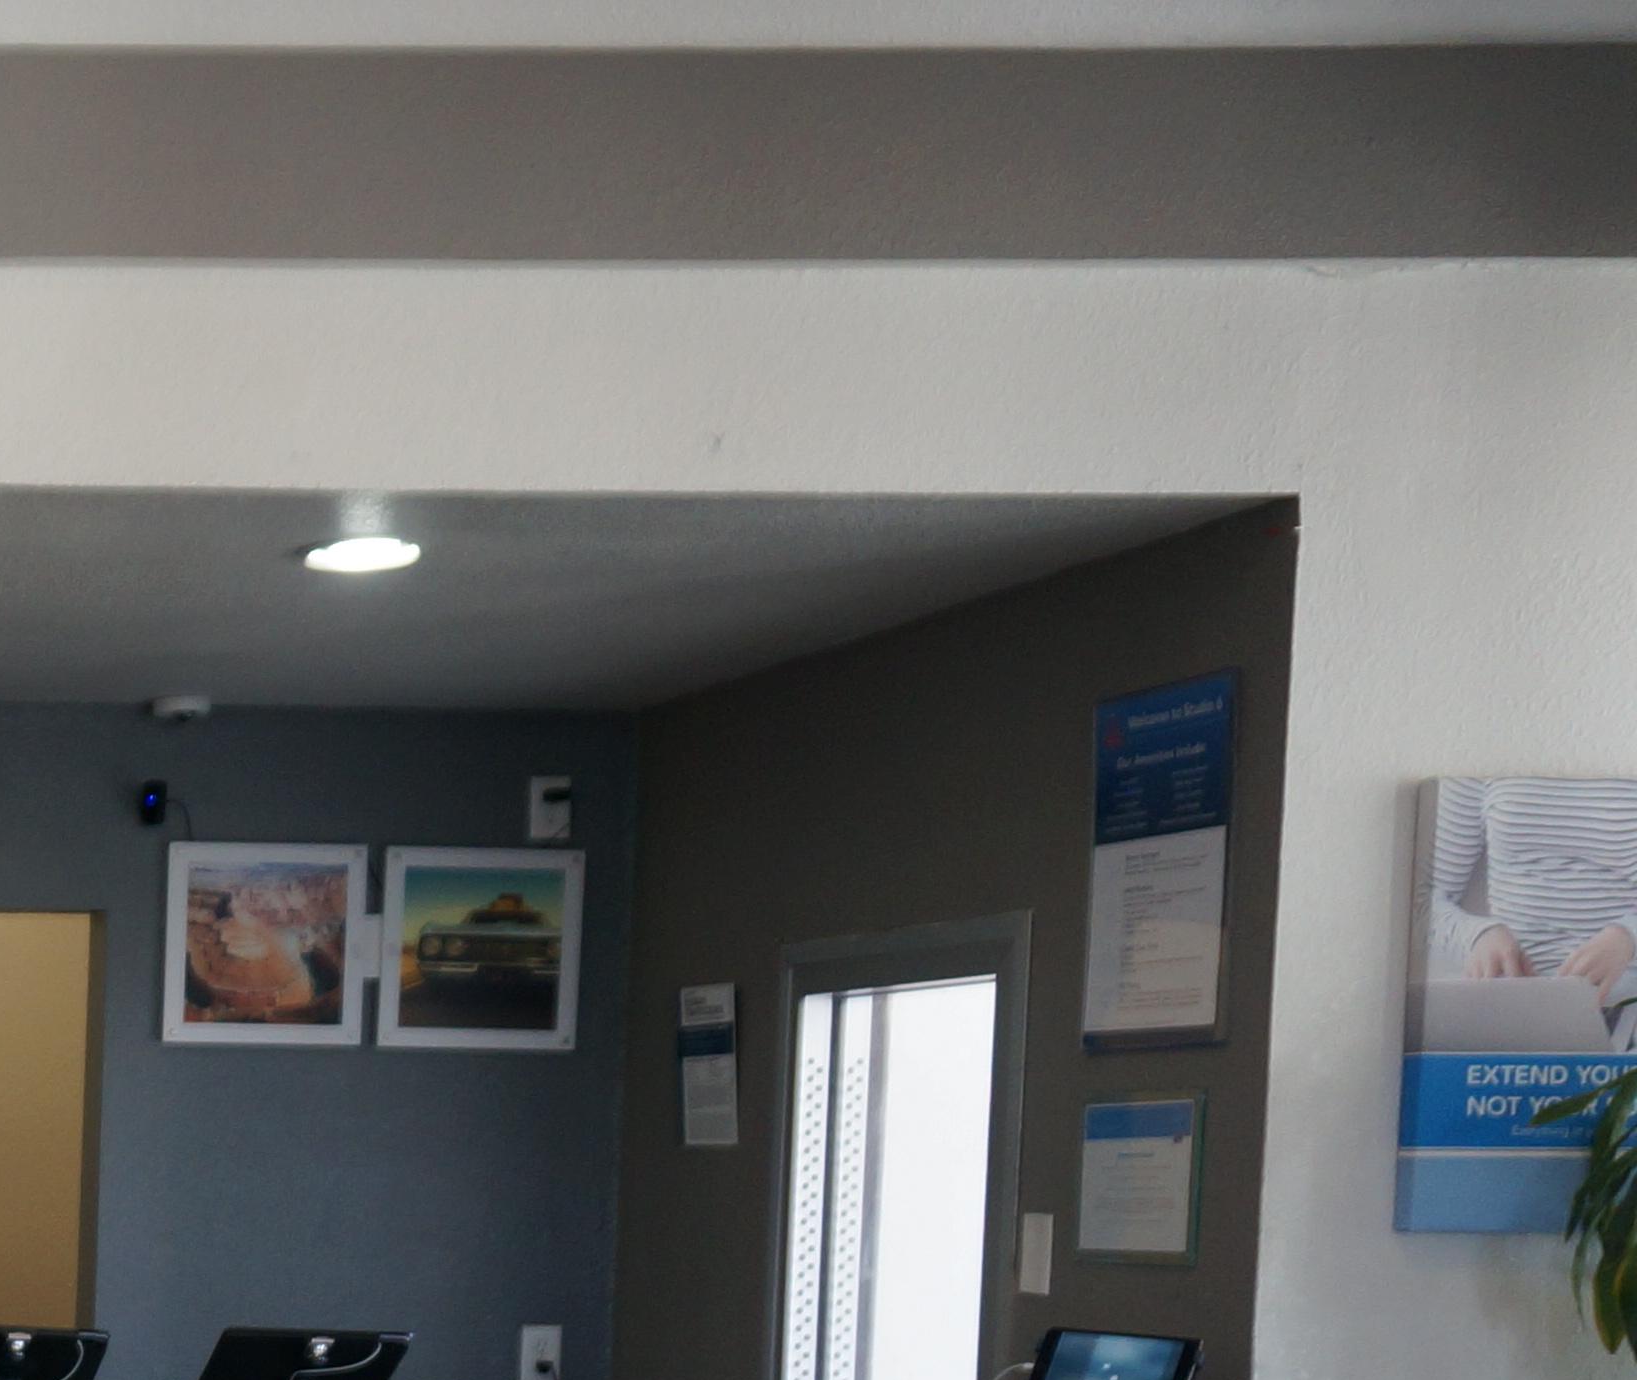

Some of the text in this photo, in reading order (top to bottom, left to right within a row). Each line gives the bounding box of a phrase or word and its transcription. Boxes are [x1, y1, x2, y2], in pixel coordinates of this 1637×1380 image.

[1467, 1065, 1637, 1085] EXTEND YOU
[1467, 1096, 1522, 1117] NOT
